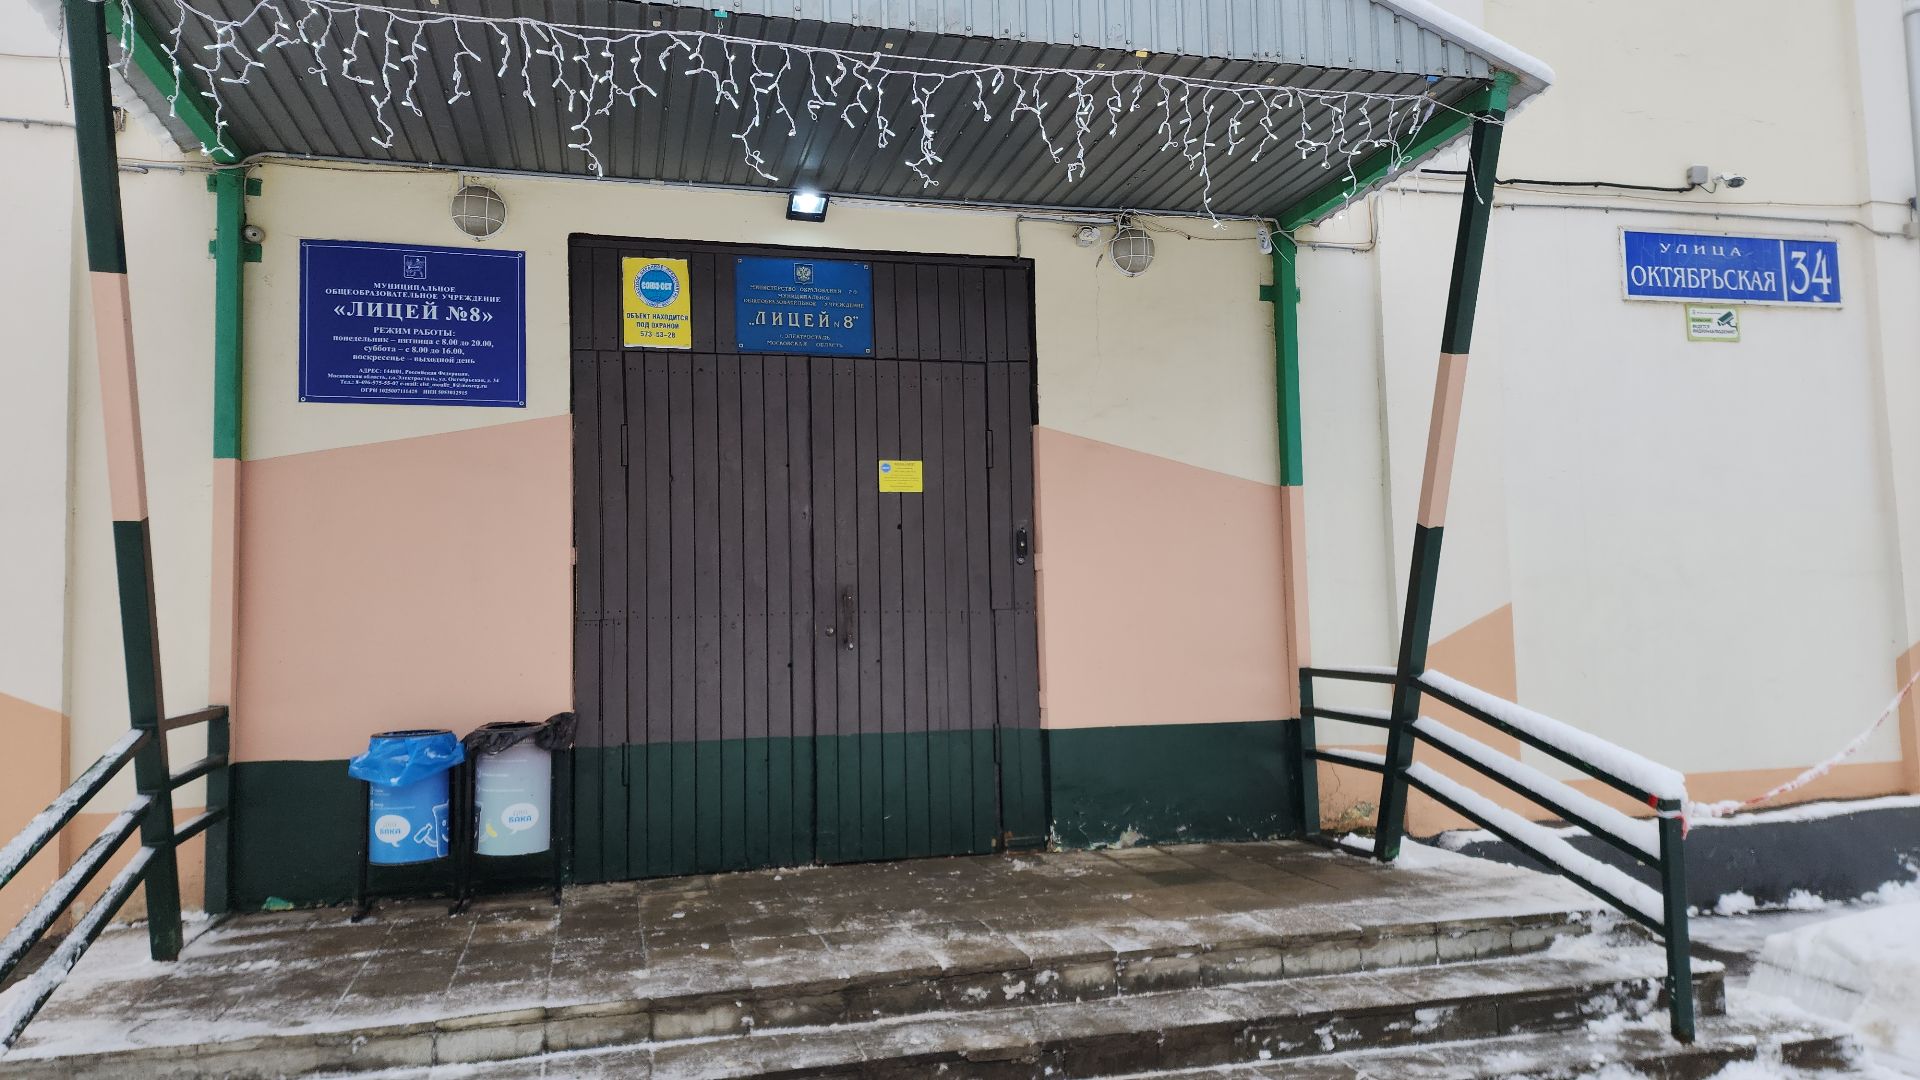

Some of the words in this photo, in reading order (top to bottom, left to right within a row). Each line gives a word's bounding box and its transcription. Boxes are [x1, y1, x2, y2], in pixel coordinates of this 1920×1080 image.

[1660, 242, 1742, 257] УЛИЦА
[1790, 249, 1832, 296] 34
[1631, 265, 1777, 292] ОКТЯБРЬСКАЯ
[373, 282, 456, 293] МУНИЦИПАЛЬНОЕ
[750, 284, 796, 292] МИНИСТЕРСТВО
[325, 288, 439, 300] ОБЩЕОБРАЗОВАТЕЛЬНОЕ
[441, 294, 501, 303] УЧРЕЖДЕНИЕ
[824, 301, 865, 309] УЧРЕЖДЕНИЕ
[333, 301, 439, 322] «ЛИЦЕЙ
[445, 305, 493, 323] №8»
[626, 312, 651, 320] ОБЪЕКТ
[652, 313, 689, 321] НАХОДИТСЯ
[636, 321, 650, 329] ПОД
[373, 326, 411, 336] РЕЖИМ
[413, 327, 456, 337] РАБОТЫ:
[333, 335, 389, 343] понедельник
[441, 338, 458, 346] 8.00
[363, 344, 396, 353] суббота
[411, 346, 428, 354] 8.00
[352, 354, 405, 363] воскресенье
[414, 356, 454, 364] выходной
